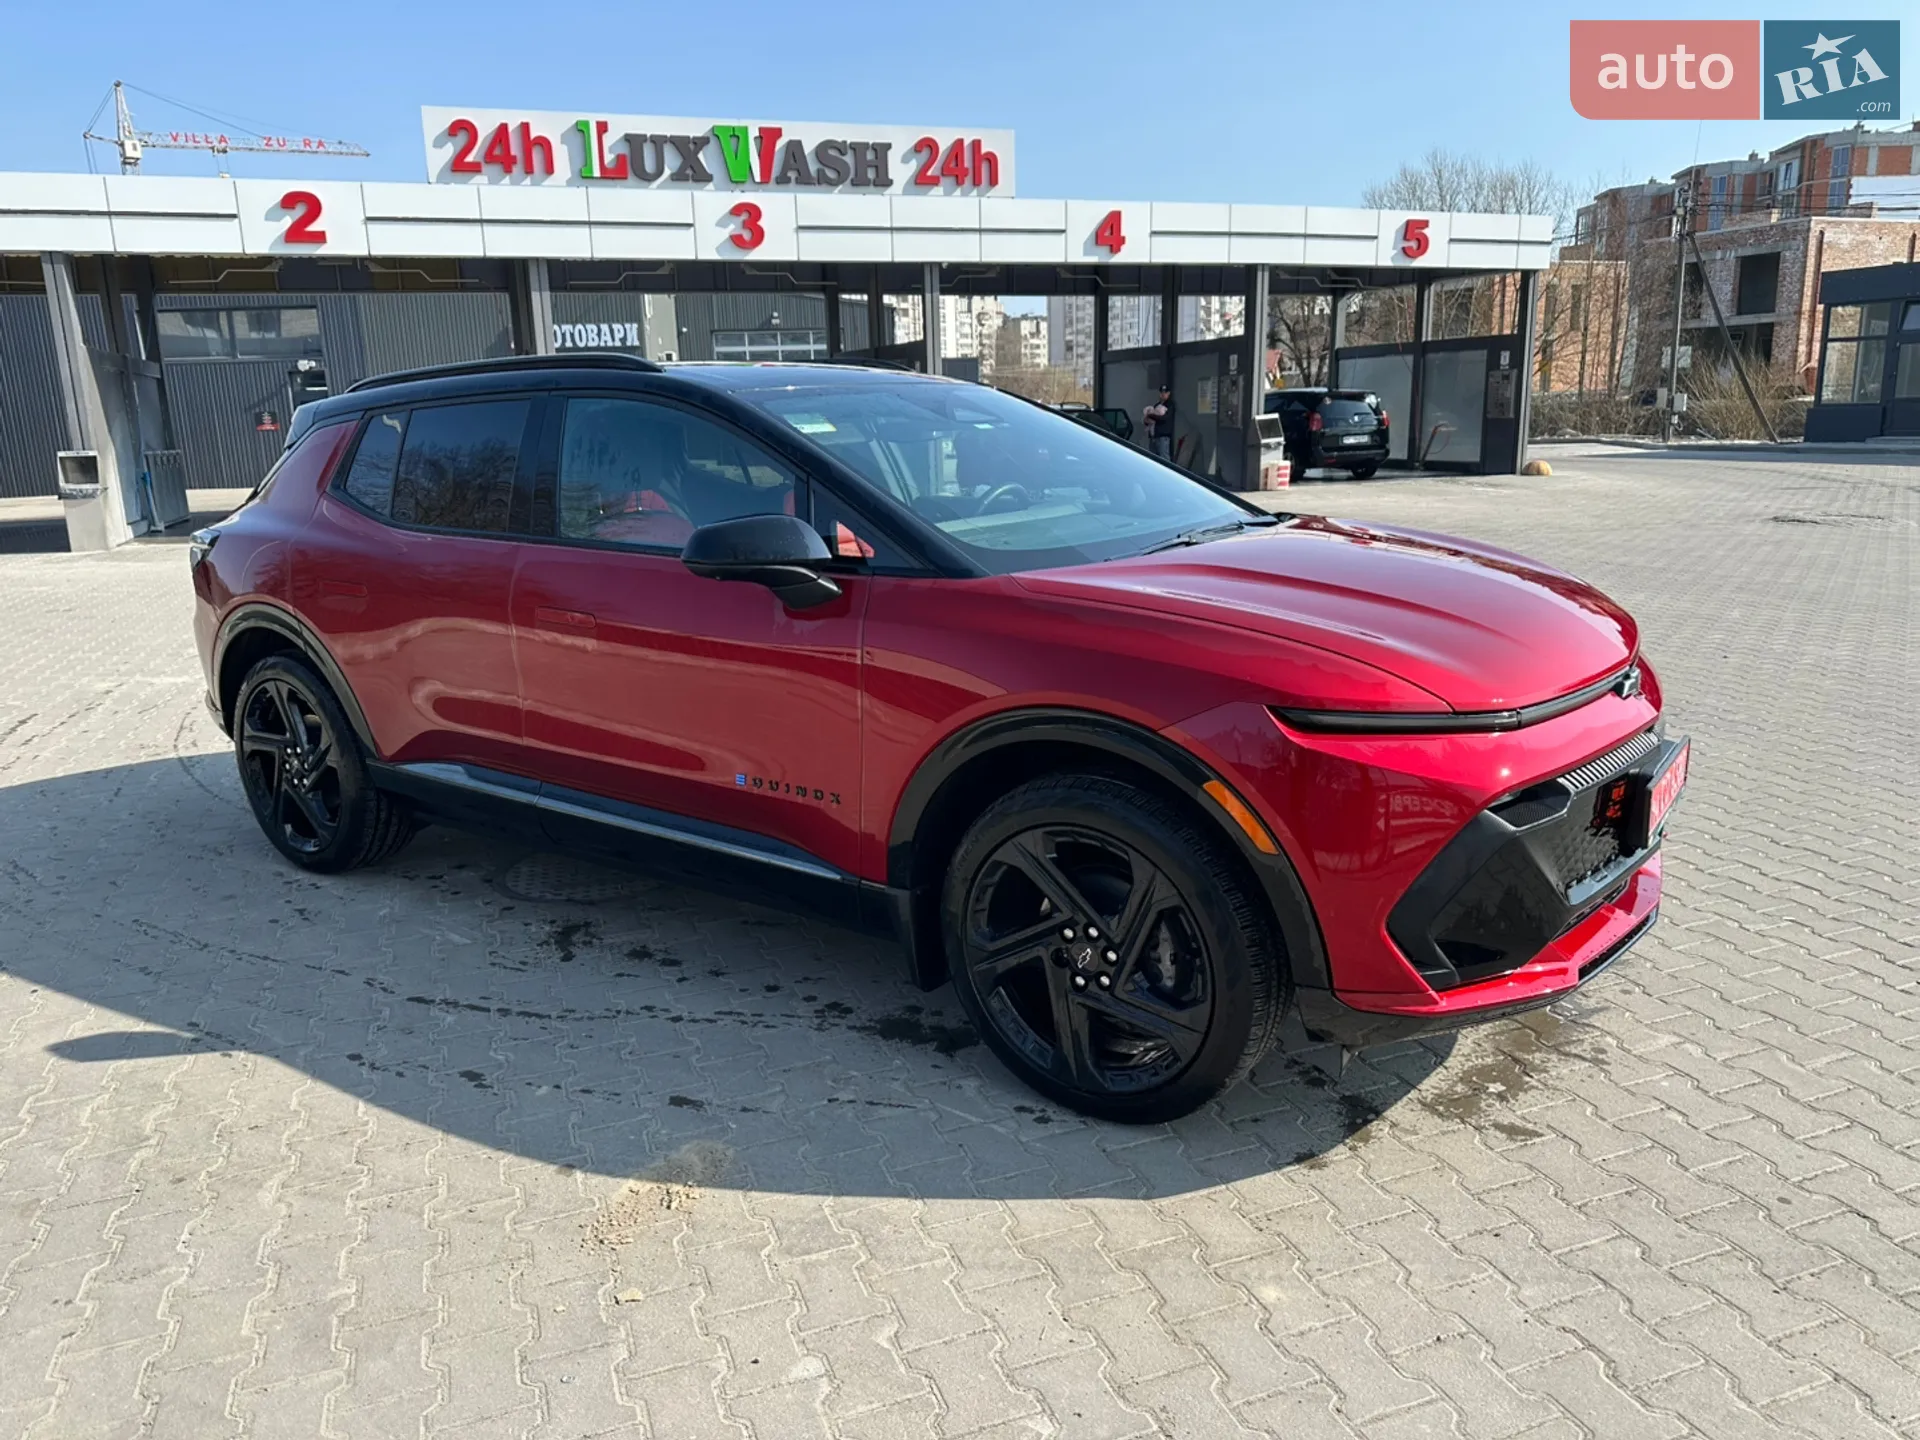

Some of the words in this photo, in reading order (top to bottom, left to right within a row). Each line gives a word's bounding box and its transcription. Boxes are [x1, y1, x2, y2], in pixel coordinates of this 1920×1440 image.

[169, 131, 229, 145] VILLA
[448, 118, 555, 175] 24h
[914, 136, 999, 186] 24h
[280, 190, 327, 244] 2
[730, 201, 765, 250] 3
[1095, 210, 1126, 254] 4
[1403, 219, 1430, 259] 5
[553, 323, 640, 348] ОТОВАРИ
[735, 773, 841, 805] EQUINOX
